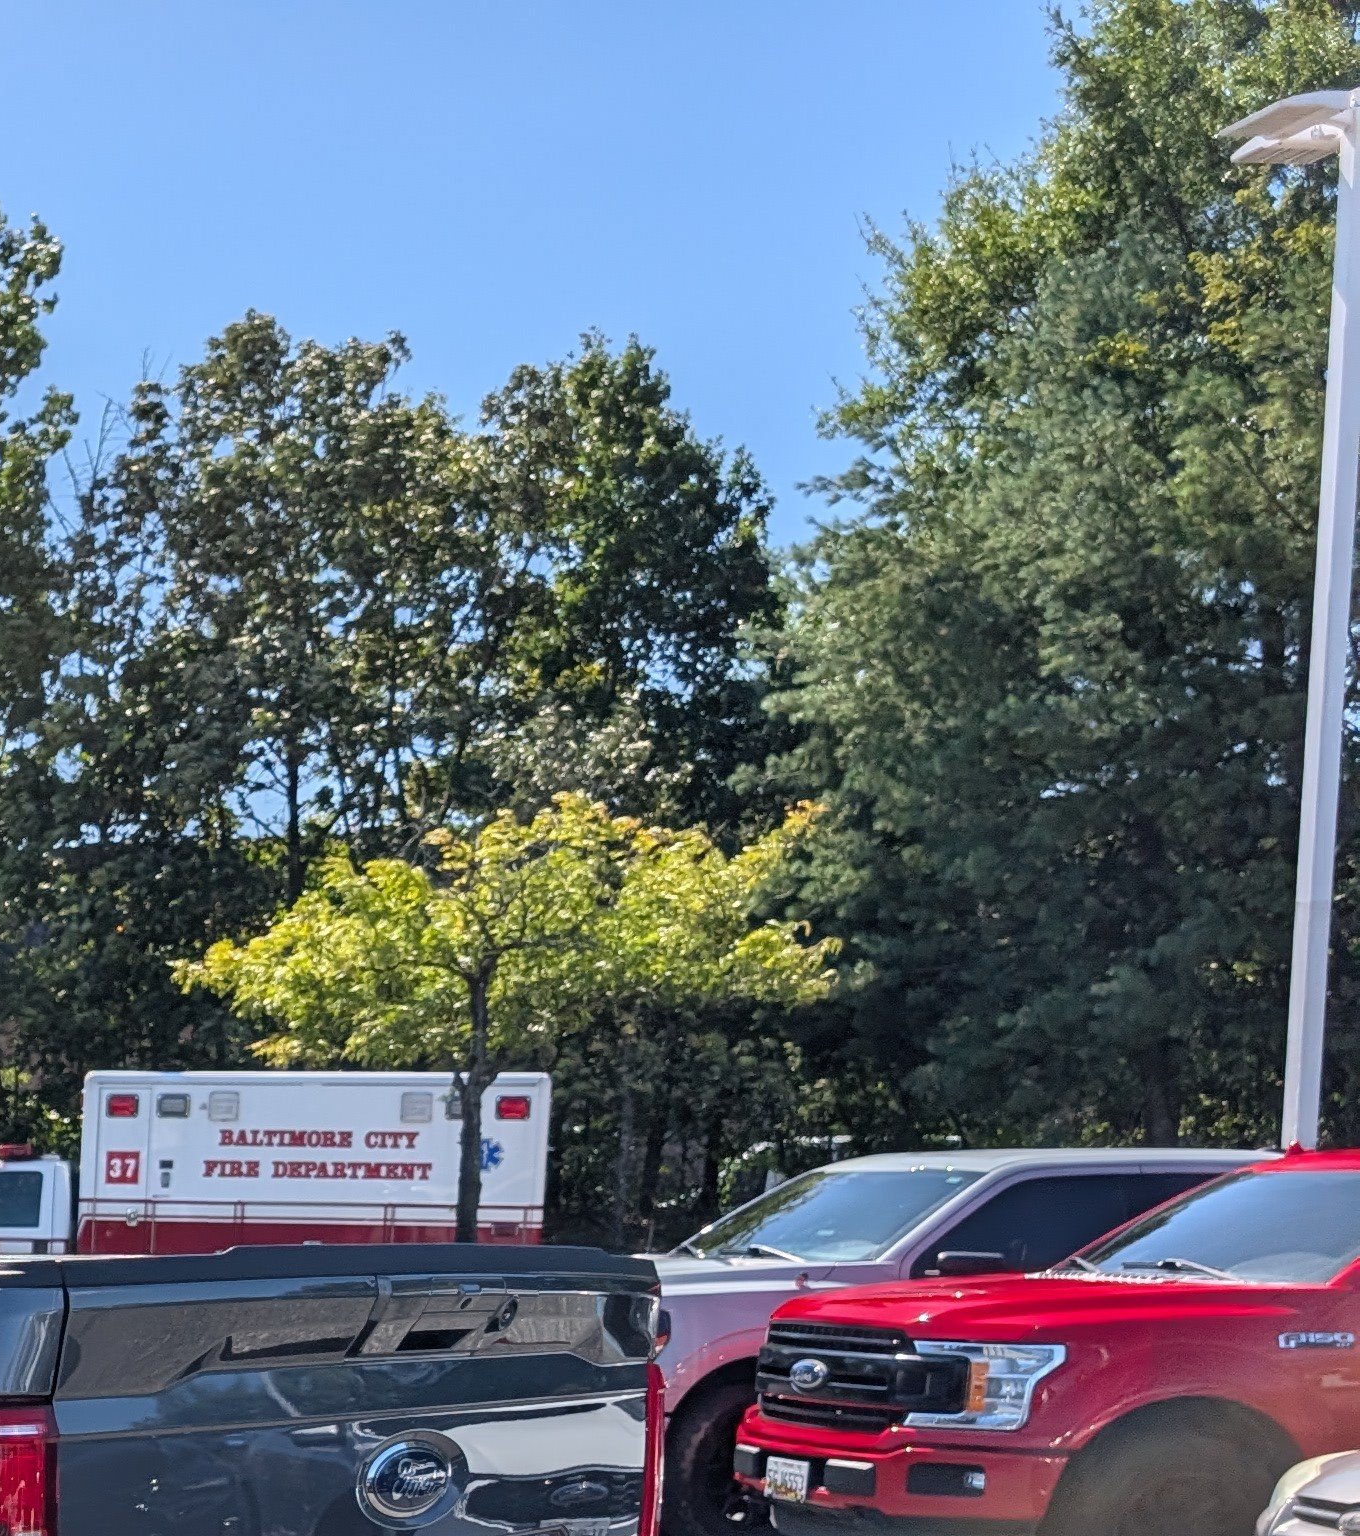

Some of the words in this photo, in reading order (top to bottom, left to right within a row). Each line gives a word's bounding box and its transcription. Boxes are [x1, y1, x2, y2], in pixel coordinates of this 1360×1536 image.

[219, 1129, 353, 1149] BALTIMORE
[364, 1131, 420, 1149] CITY
[108, 1157, 137, 1179] 37
[202, 1160, 261, 1178] FIRE
[271, 1161, 433, 1181] DEPARTMENT
